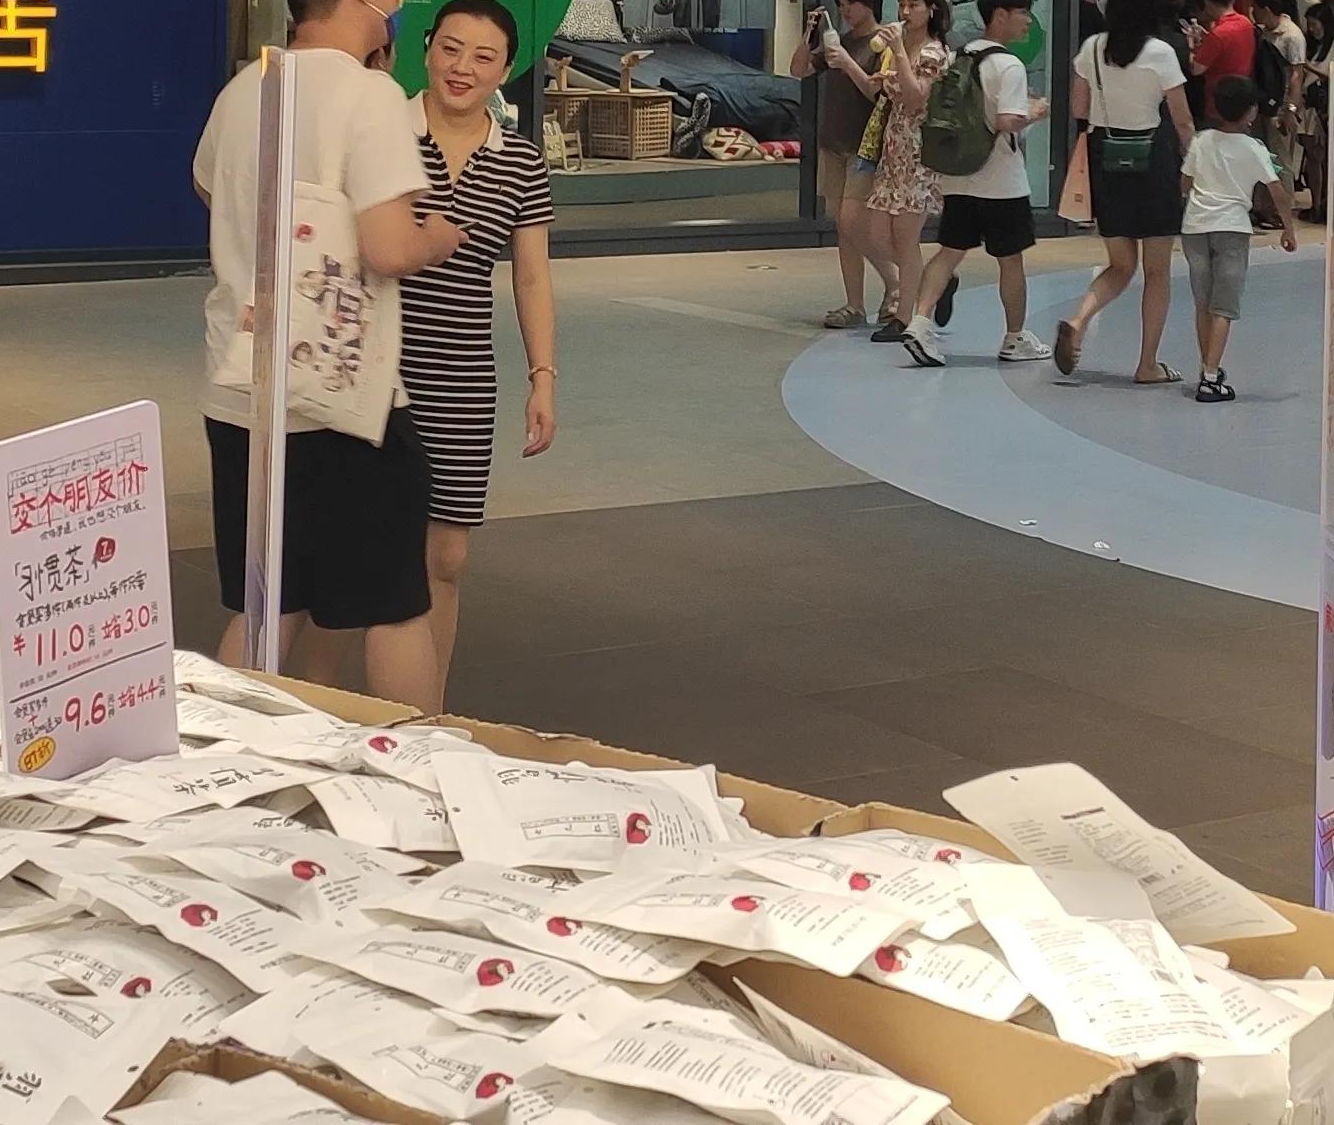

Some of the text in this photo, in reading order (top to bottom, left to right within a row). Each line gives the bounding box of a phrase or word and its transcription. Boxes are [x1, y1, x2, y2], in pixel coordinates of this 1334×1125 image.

[10, 459, 149, 535] 交个朋友价
[64, 691, 107, 733] 9.6
